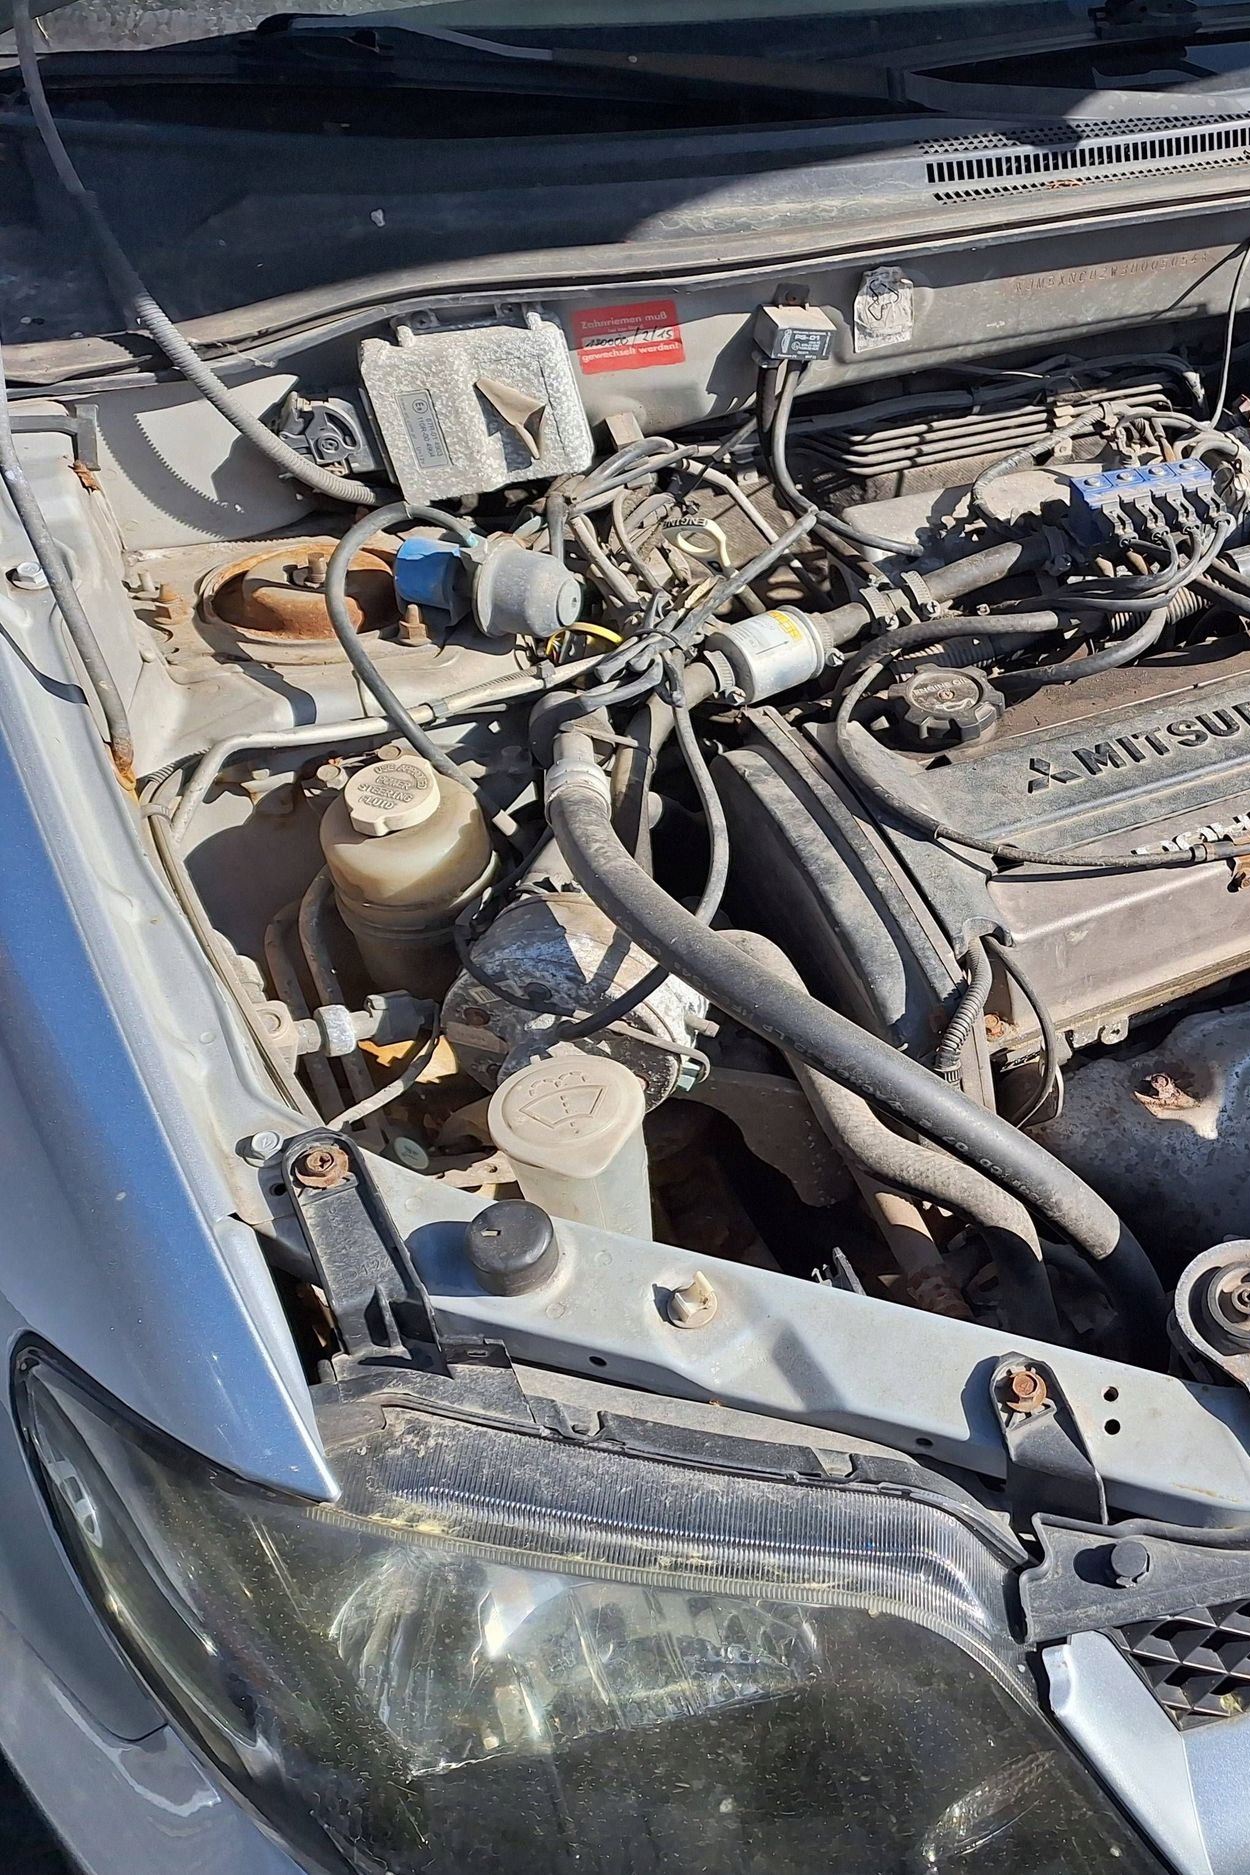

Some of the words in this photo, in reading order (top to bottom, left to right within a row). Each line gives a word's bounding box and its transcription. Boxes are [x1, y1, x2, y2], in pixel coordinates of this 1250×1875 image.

[581, 315, 642, 329] Zahnriemen
[645, 311, 667, 321] muß
[638, 342, 679, 354] werden!
[375, 775, 412, 791] POWER
[357, 783, 414, 803] STEERING
[358, 795, 397, 810] FLUID
